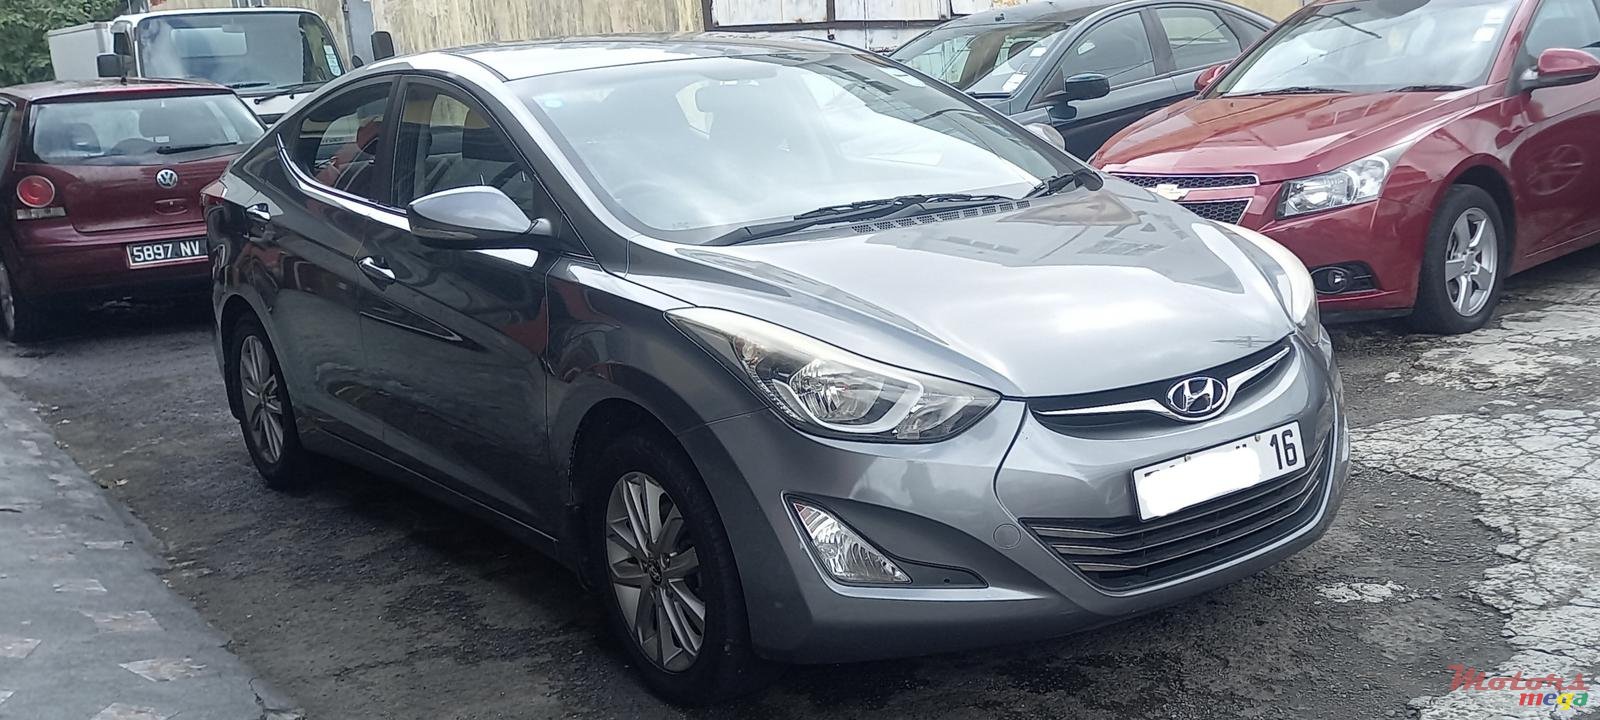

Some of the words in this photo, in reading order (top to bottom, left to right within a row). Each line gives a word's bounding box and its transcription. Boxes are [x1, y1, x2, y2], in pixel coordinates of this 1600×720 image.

[133, 243, 173, 261] 5897
[180, 241, 200, 257] NV
[1269, 429, 1298, 470] 16
